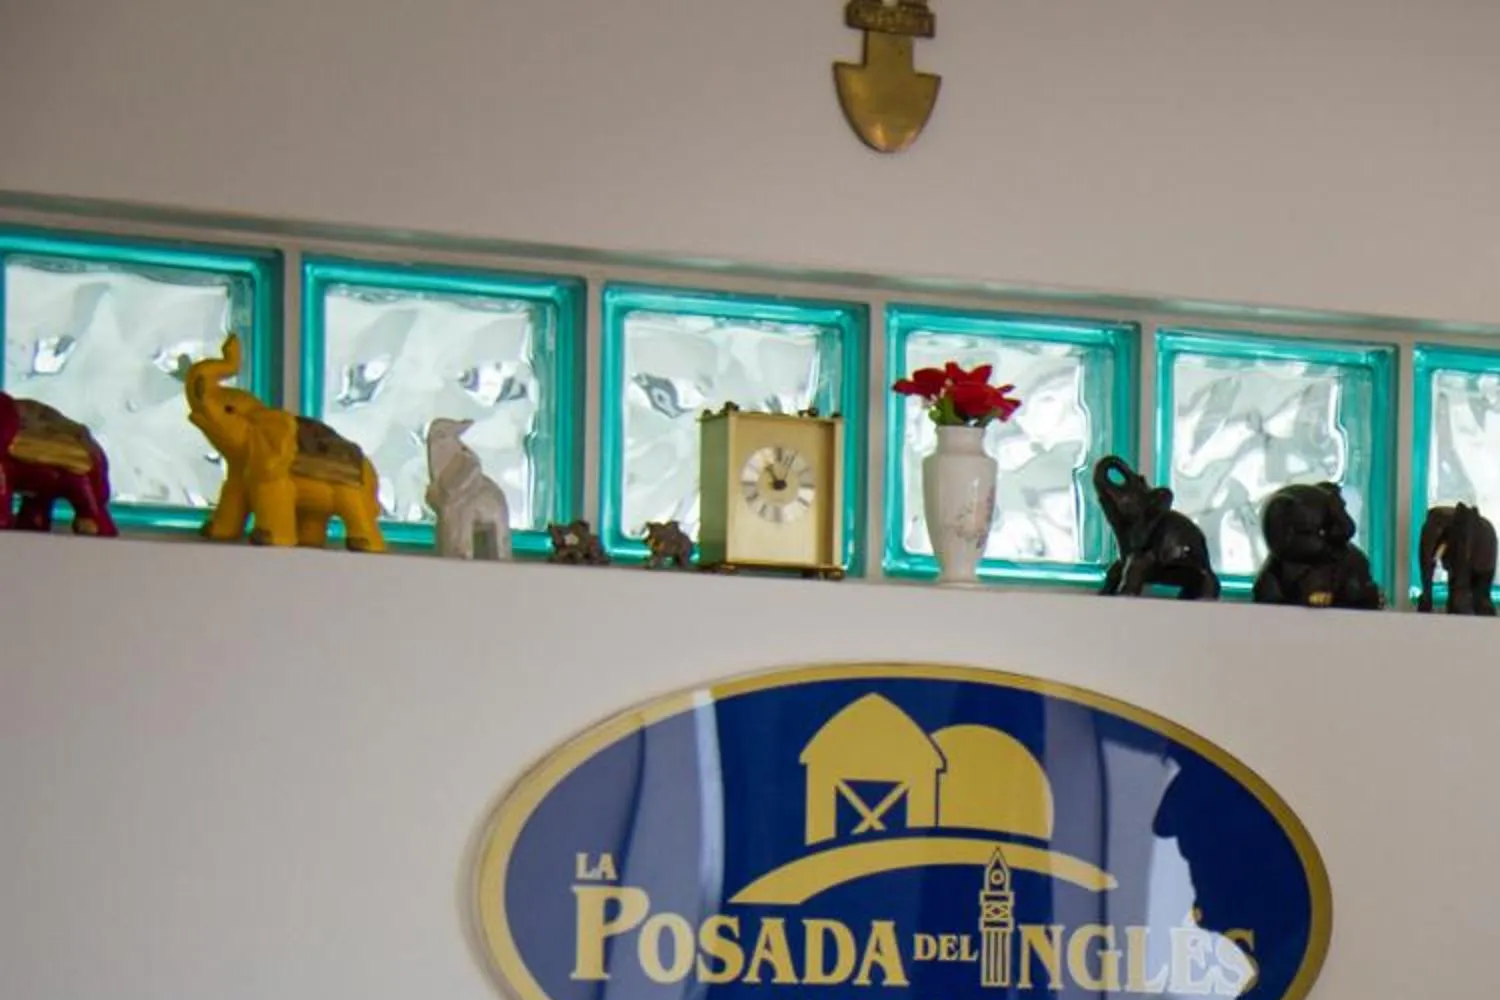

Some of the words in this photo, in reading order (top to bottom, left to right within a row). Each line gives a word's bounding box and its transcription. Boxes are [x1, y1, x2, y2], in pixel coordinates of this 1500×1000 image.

[576, 852, 618, 881] LA
[569, 884, 911, 988] POSADA
[912, 932, 978, 963] DEL
